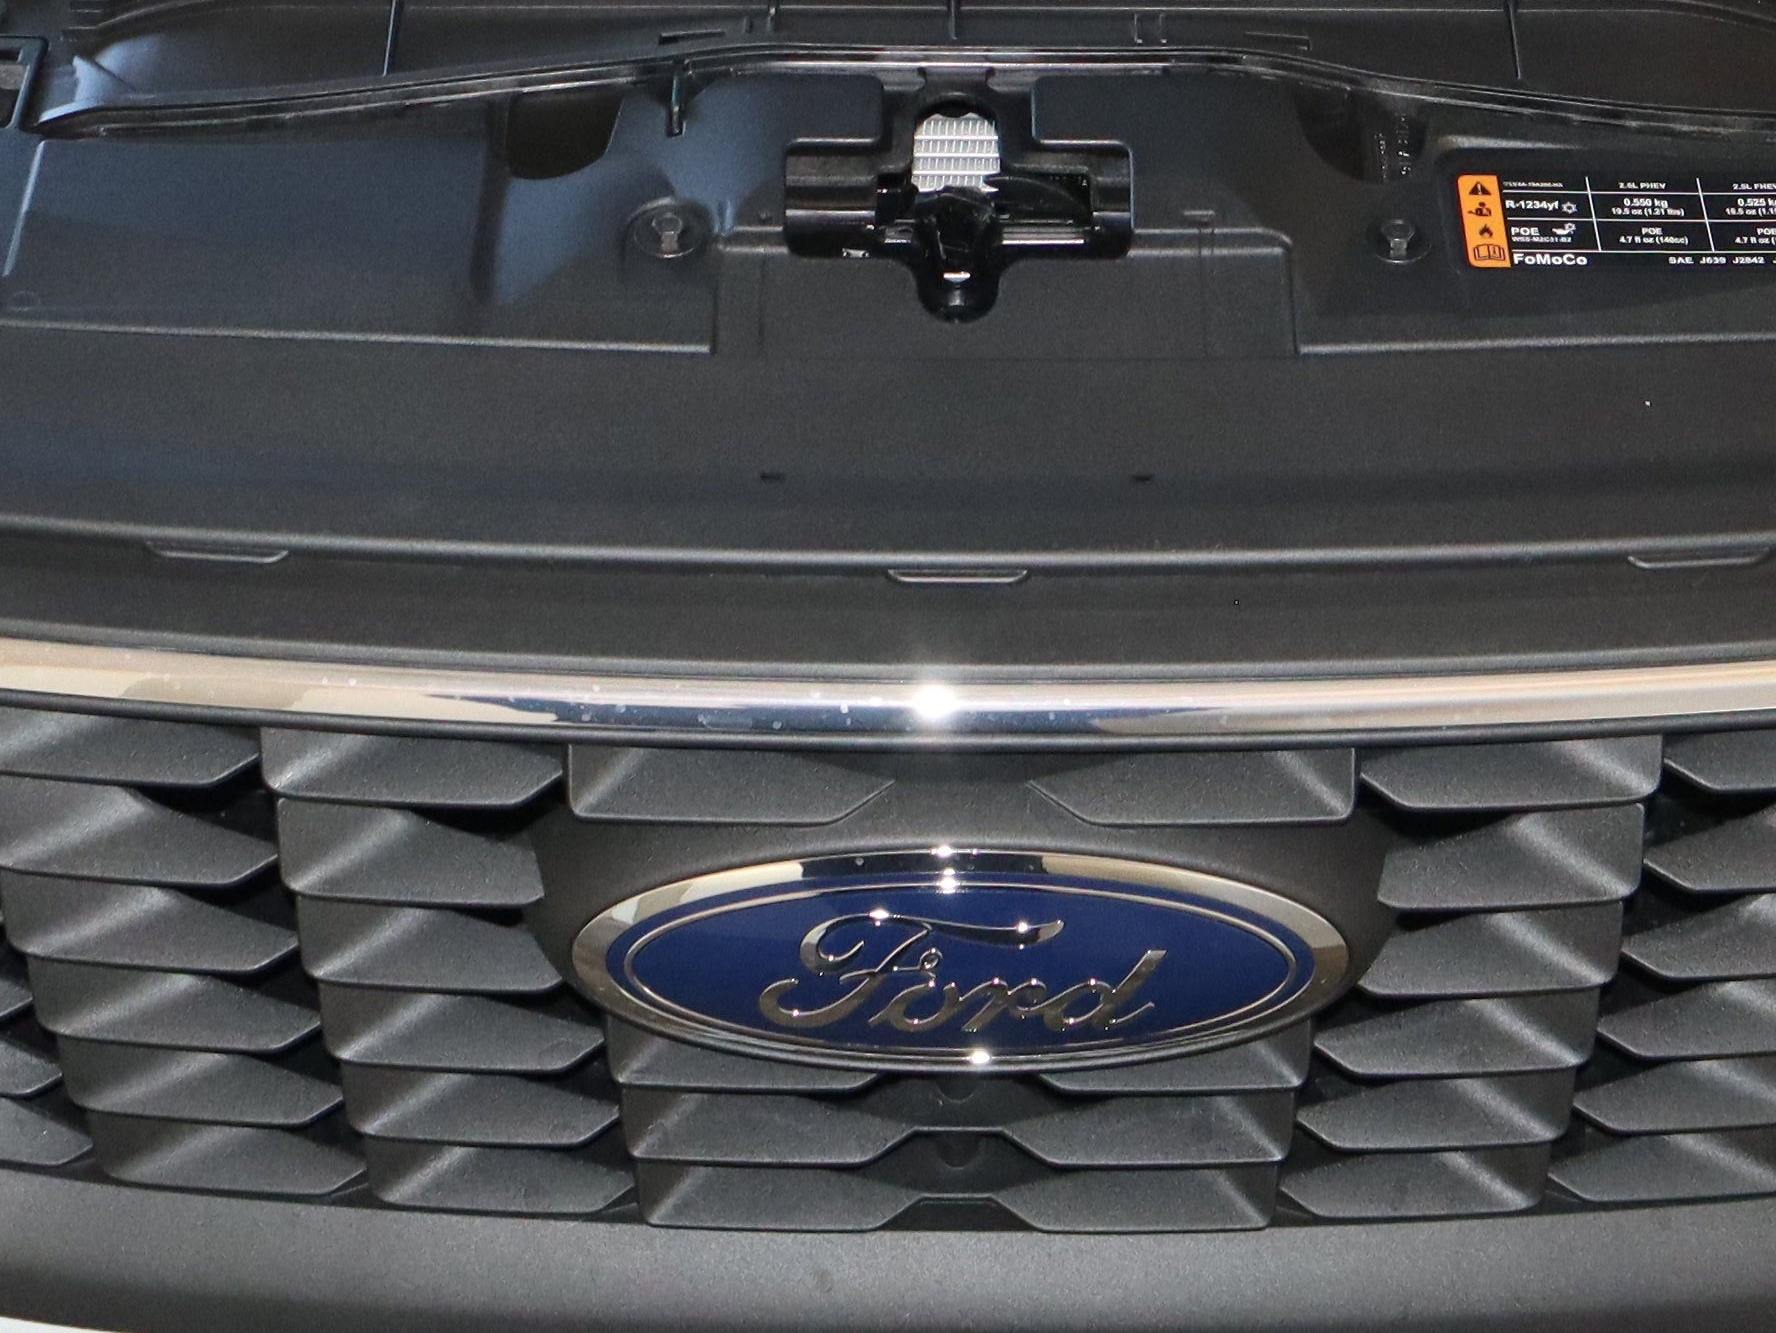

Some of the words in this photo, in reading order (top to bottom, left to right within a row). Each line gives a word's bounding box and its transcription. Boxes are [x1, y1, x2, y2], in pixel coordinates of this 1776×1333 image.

[1640, 182, 1667, 190] PHEV
[1505, 199, 1559, 211] R-1234yf
[1654, 197, 1669, 209] kg
[1511, 227, 1540, 236] POE
[1641, 227, 1663, 235] POE
[1513, 252, 1588, 266] FoMoCo
[1668, 256, 1694, 264] SAE
[759, 910, 1168, 1032] Ford
